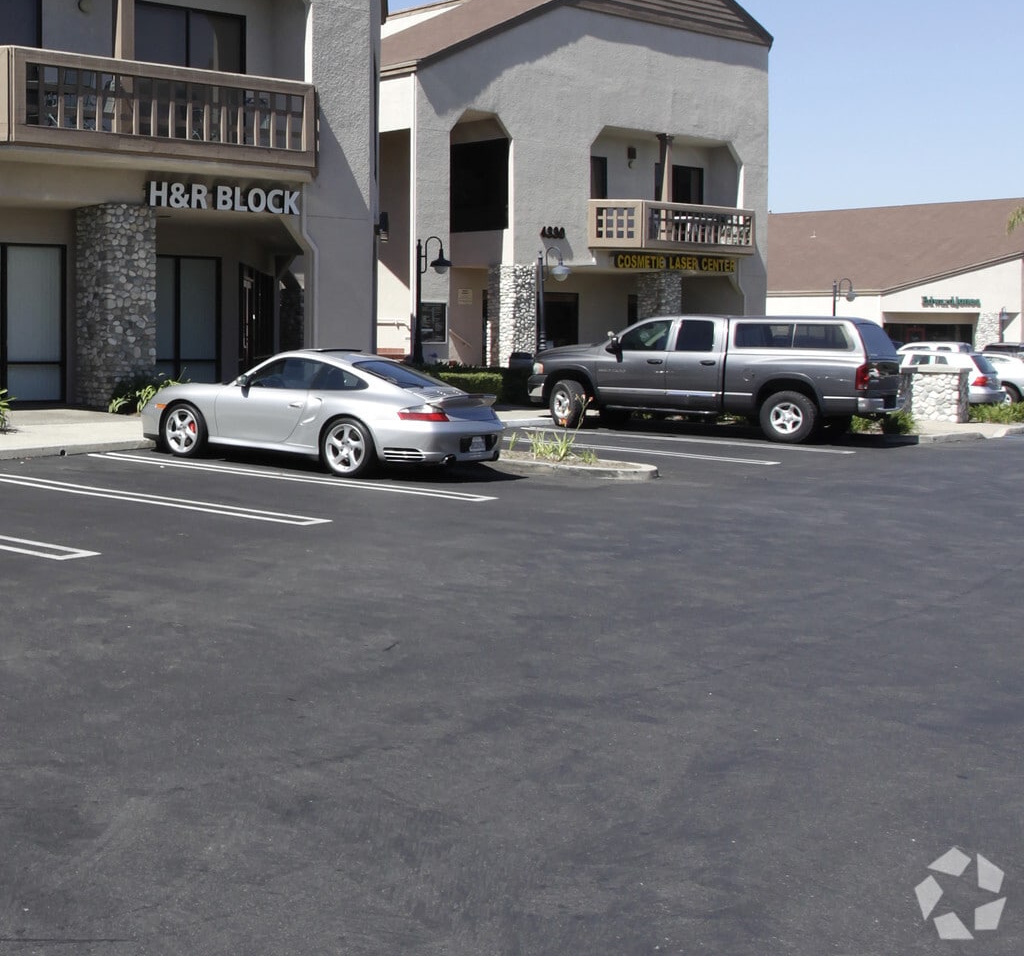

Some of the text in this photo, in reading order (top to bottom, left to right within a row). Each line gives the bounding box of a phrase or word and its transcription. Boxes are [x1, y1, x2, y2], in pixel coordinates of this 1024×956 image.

[149, 180, 301, 215] H&R BLOCK
[617, 254, 736, 272] COSMETIC LASER CENTER
